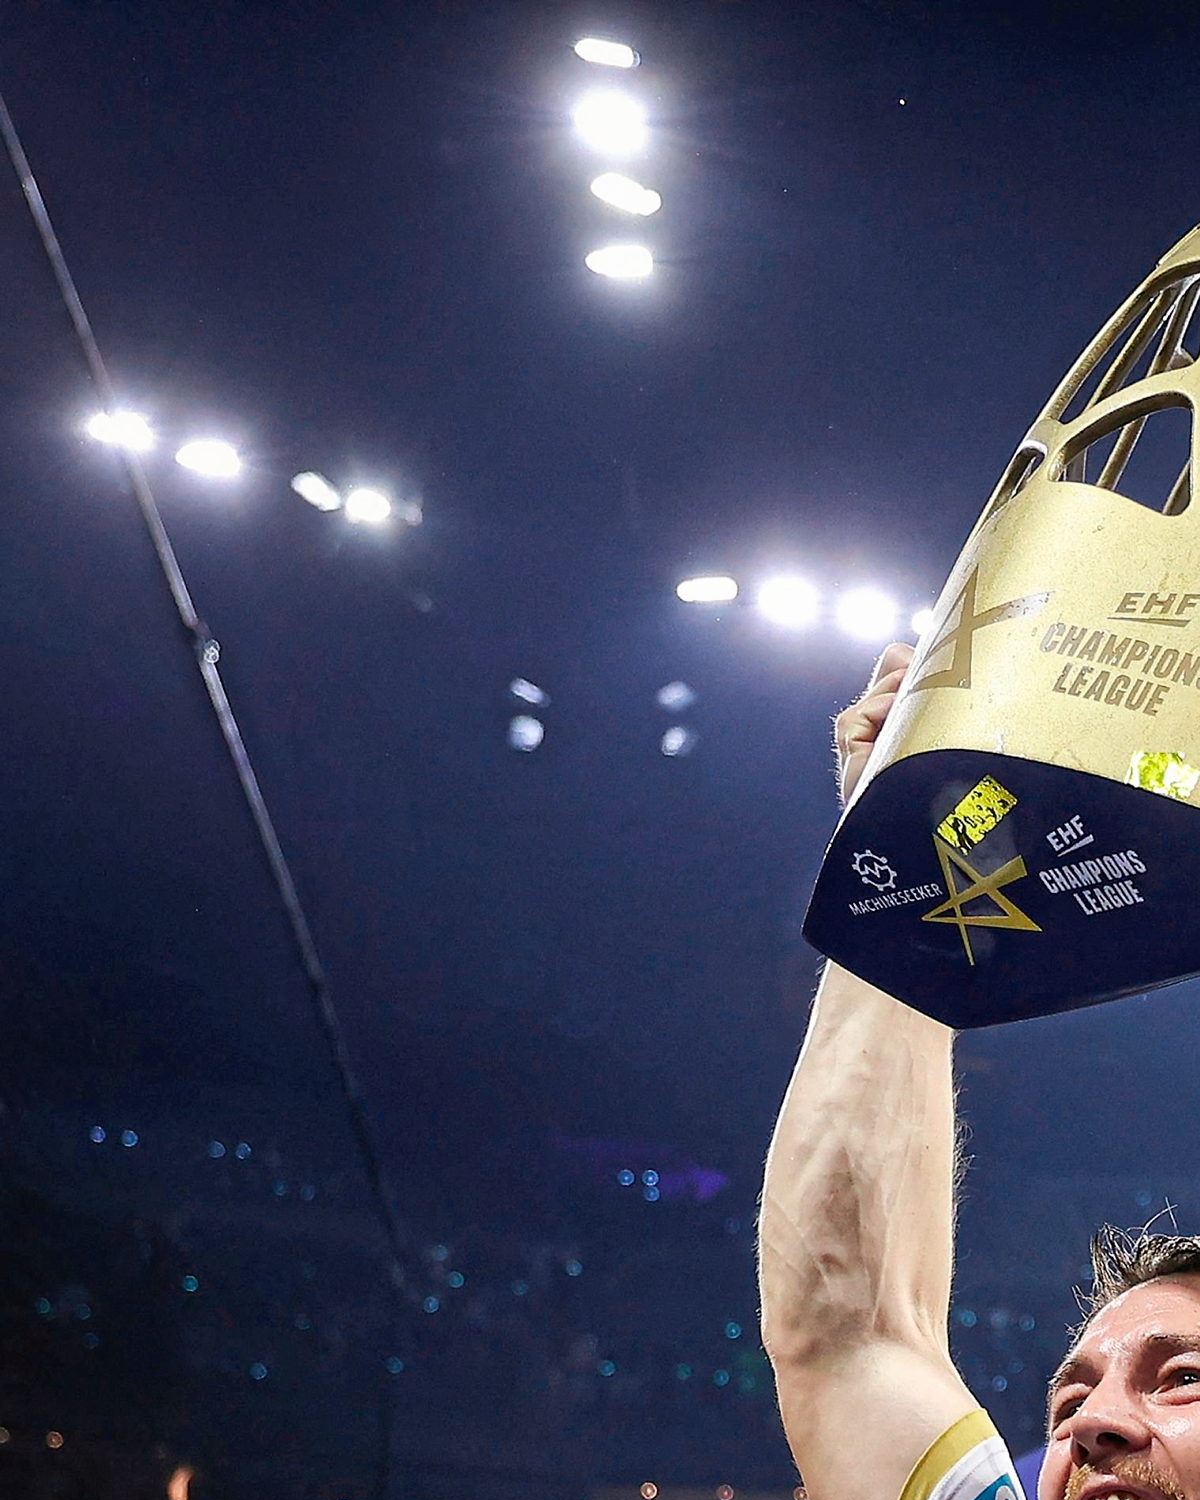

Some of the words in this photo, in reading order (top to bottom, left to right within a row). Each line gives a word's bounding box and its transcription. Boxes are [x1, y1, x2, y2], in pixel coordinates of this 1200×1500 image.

[1052, 662, 1170, 717] LEAGUE
[1046, 814, 1086, 852] EHF
[1038, 850, 1147, 894] CHAMPIONS
[848, 883, 943, 916] MACHINESEEKER
[1073, 878, 1144, 916] LEAGUE
